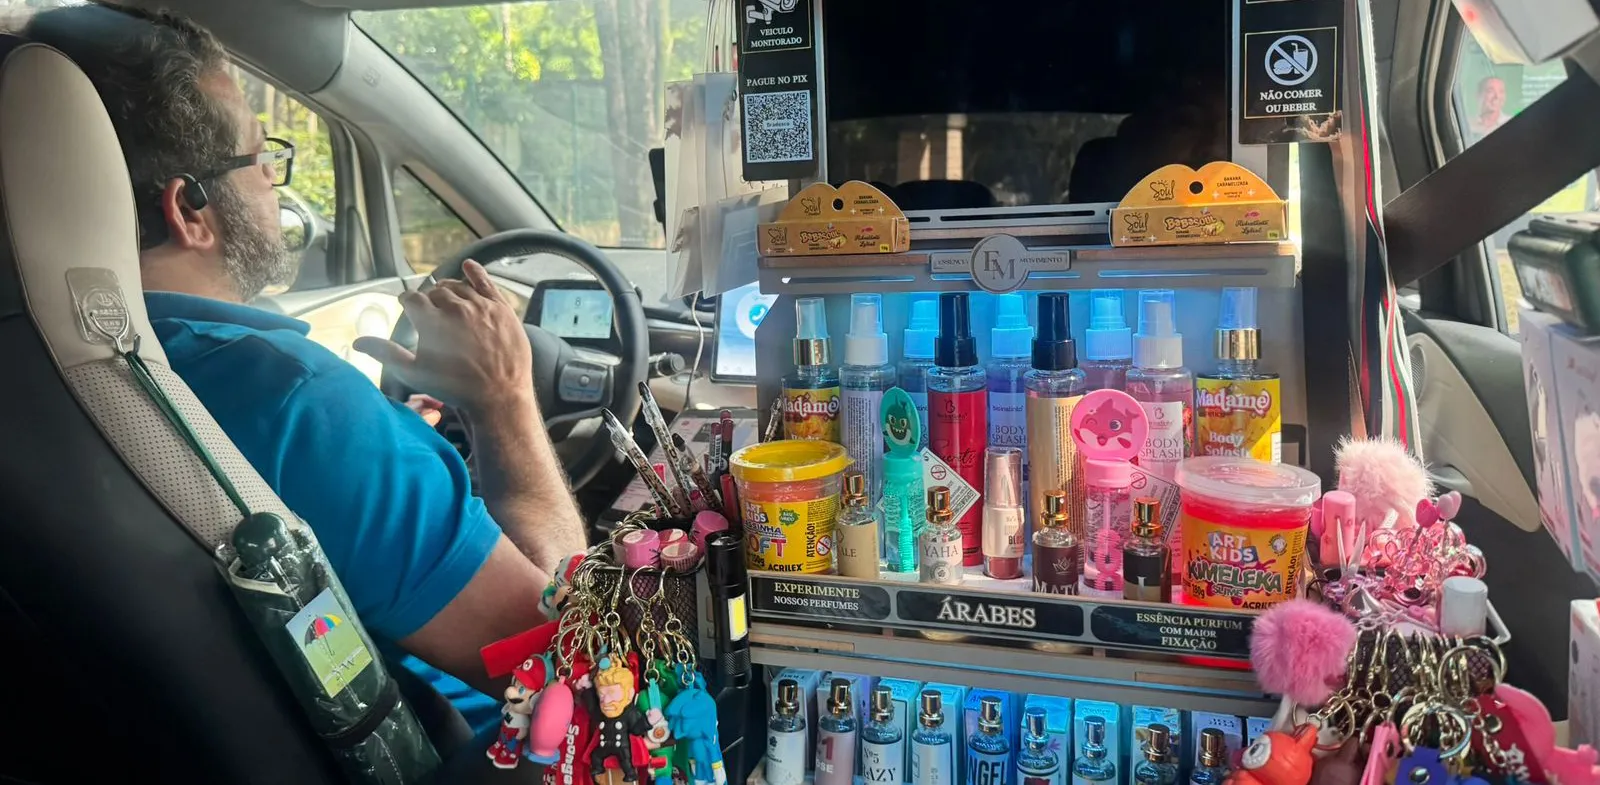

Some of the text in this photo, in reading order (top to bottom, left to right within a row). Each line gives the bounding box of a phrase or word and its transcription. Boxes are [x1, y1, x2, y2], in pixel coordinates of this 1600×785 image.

[760, 27, 793, 36] VEICULO
[751, 37, 802, 48] MONITORADO
[747, 74, 808, 87] PAGUE NO PIX
[1260, 89, 1323, 100] NÃO COMER
[1265, 102, 1317, 113] OU BEBER
[1150, 180, 1175, 198] Soul
[1123, 212, 1149, 231] Soul
[995, 425, 1025, 435] BODY
[992, 434, 1026, 444] SPLASH
[1145, 438, 1180, 449] BODY
[1209, 431, 1245, 447] Body
[1140, 448, 1182, 459] SPLASH
[745, 509, 767, 522] KIDS
[805, 523, 816, 558] ATENÇÃO!
[1212, 532, 1248, 549] ART
[1210, 547, 1255, 563] KIDS
[767, 563, 802, 572] ACRILEX
[1188, 559, 1283, 594] KIMELEKA
[774, 582, 860, 599] EXPERIMENTE
[773, 595, 859, 611] NOSSOS PERFUMES
[937, 596, 1036, 629] ÁRABES
[1136, 612, 1242, 631] ESSÊNCIA PURFUM
[1159, 626, 1217, 638] COM MAIOR
[1161, 636, 1217, 650] FIXAÇÃO
